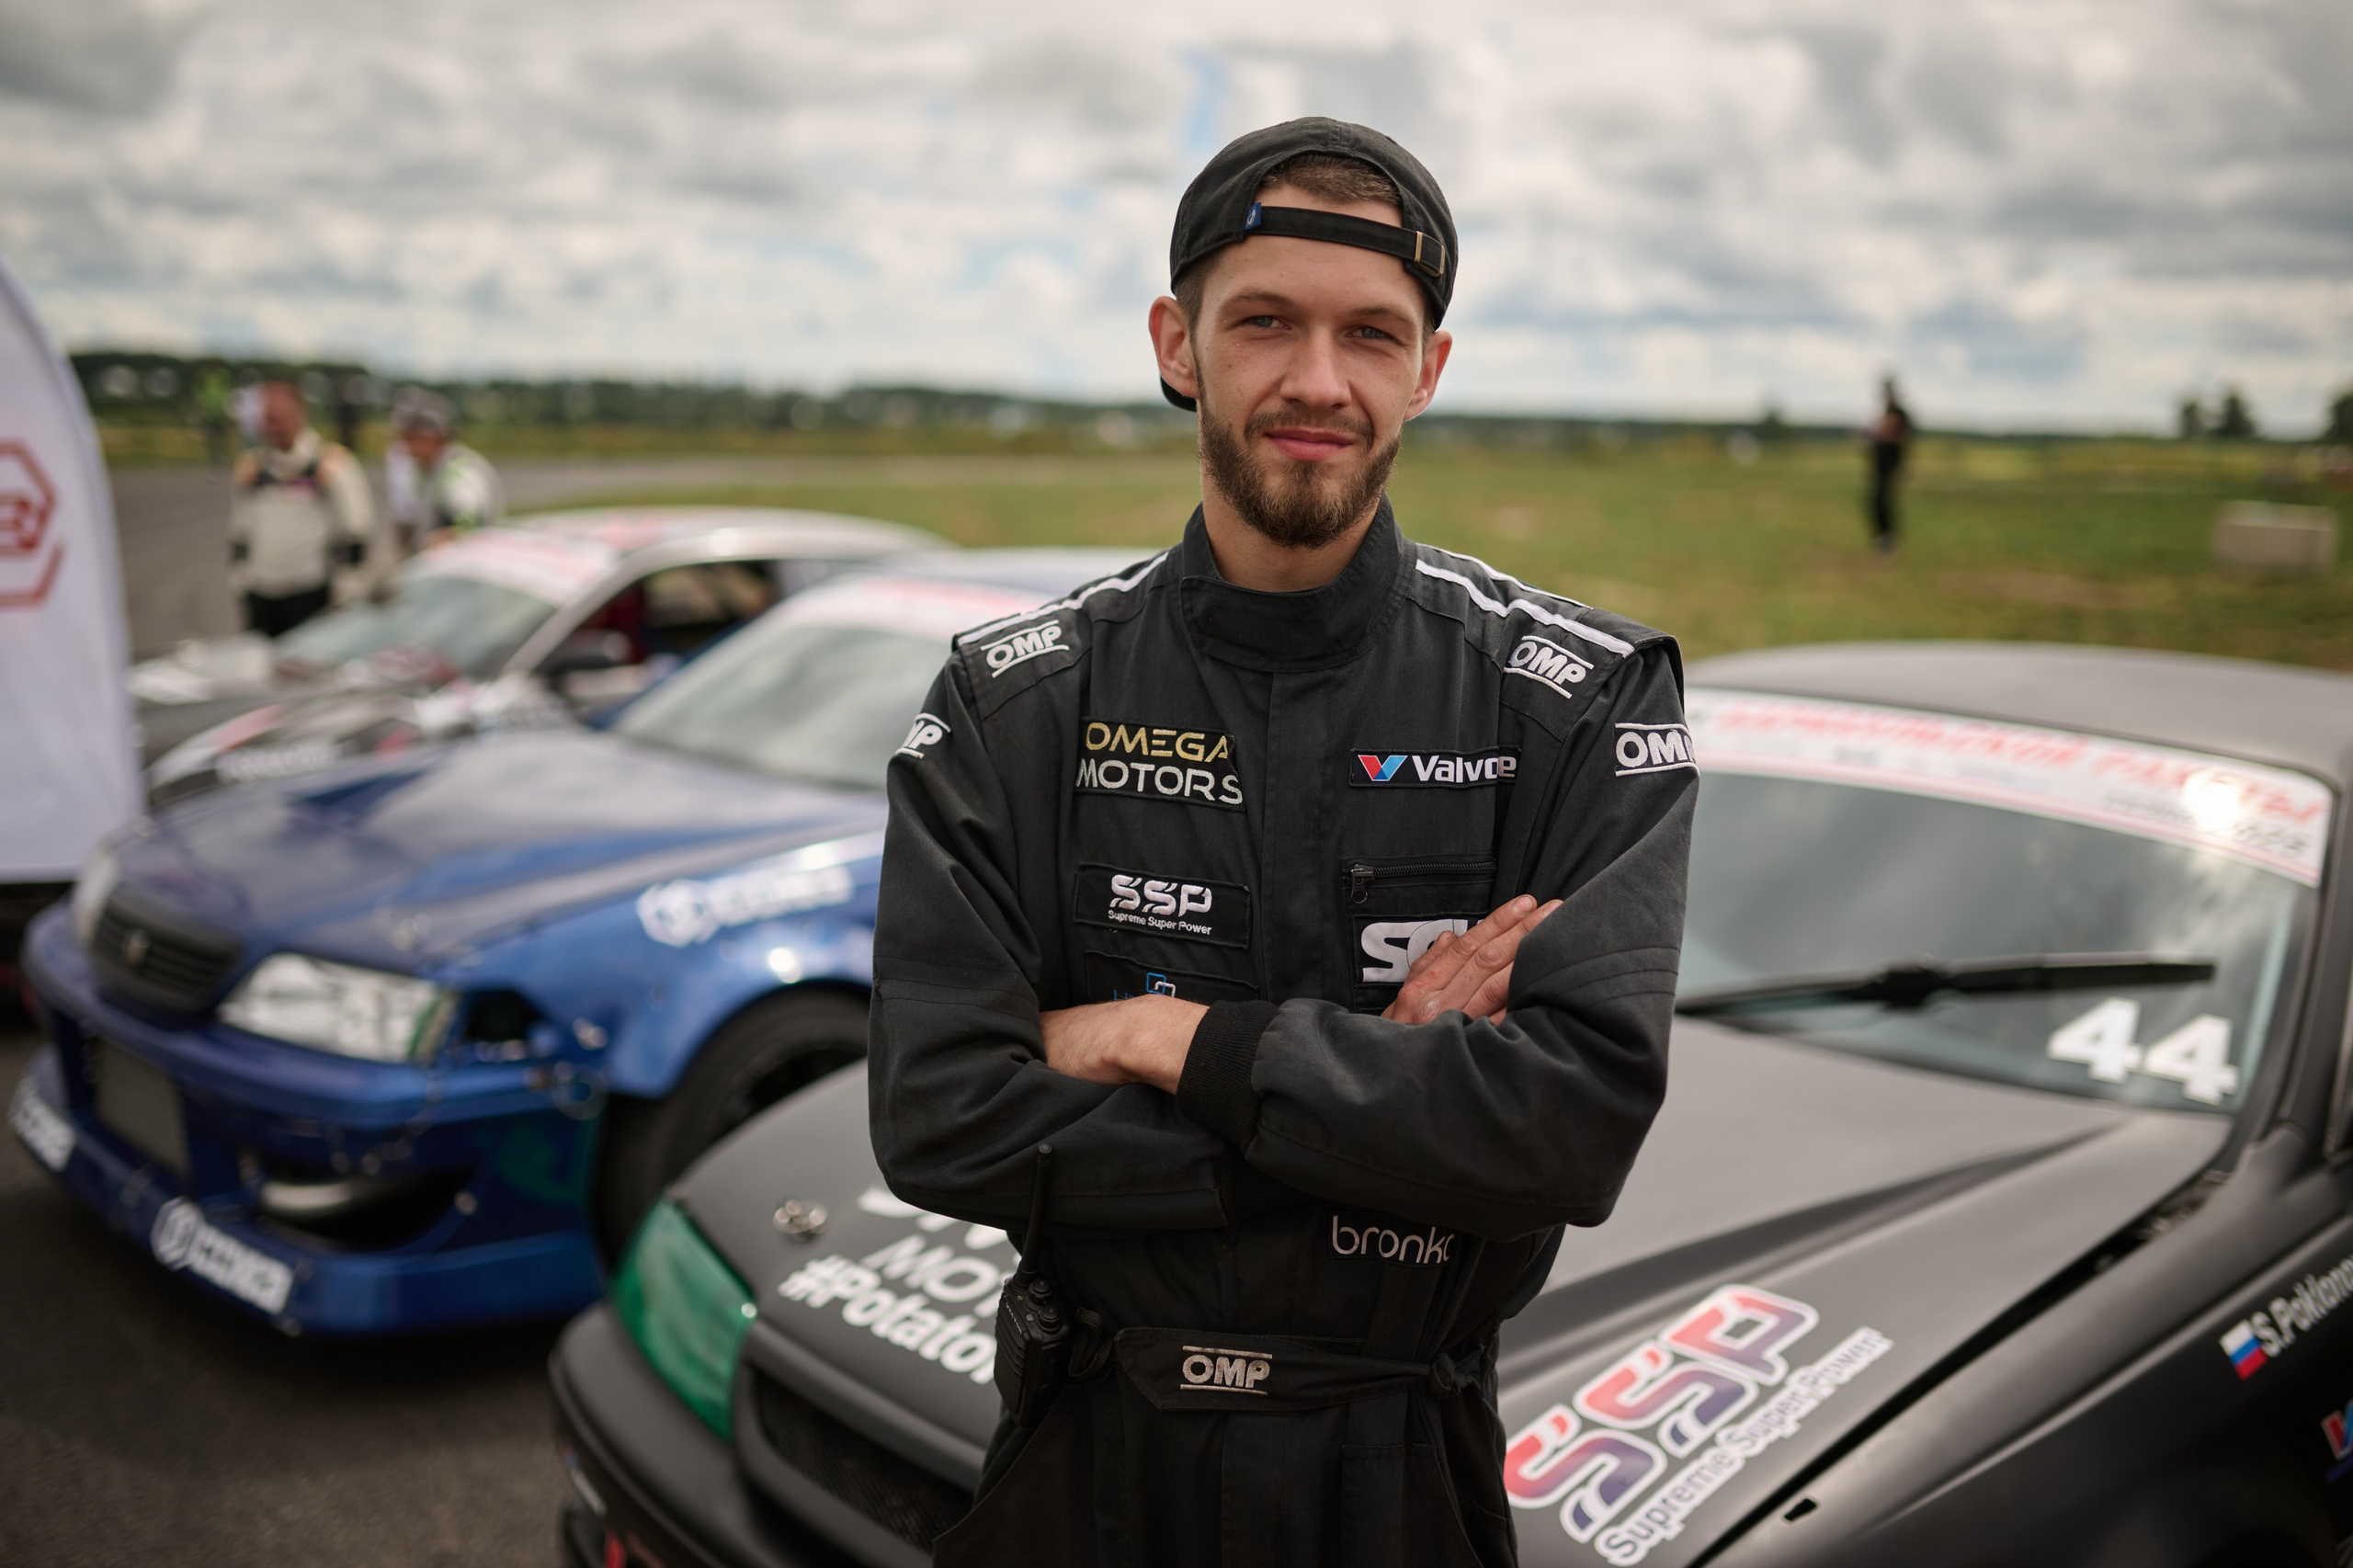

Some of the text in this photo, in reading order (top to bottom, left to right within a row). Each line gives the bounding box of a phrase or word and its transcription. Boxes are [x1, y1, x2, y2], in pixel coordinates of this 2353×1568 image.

[985, 625, 1063, 669] OMP
[1508, 641, 1586, 686] OMP
[1085, 722, 1229, 764] OMEGA
[1074, 757, 1244, 805] MOTORS
[1108, 873, 1213, 918] SSP
[1107, 909, 1212, 936] Supreme Super Power
[1181, 1353, 1271, 1389] OMP
[1504, 1284, 1820, 1544] SSP
[1600, 1328, 1890, 1562] Supreme Super Power
